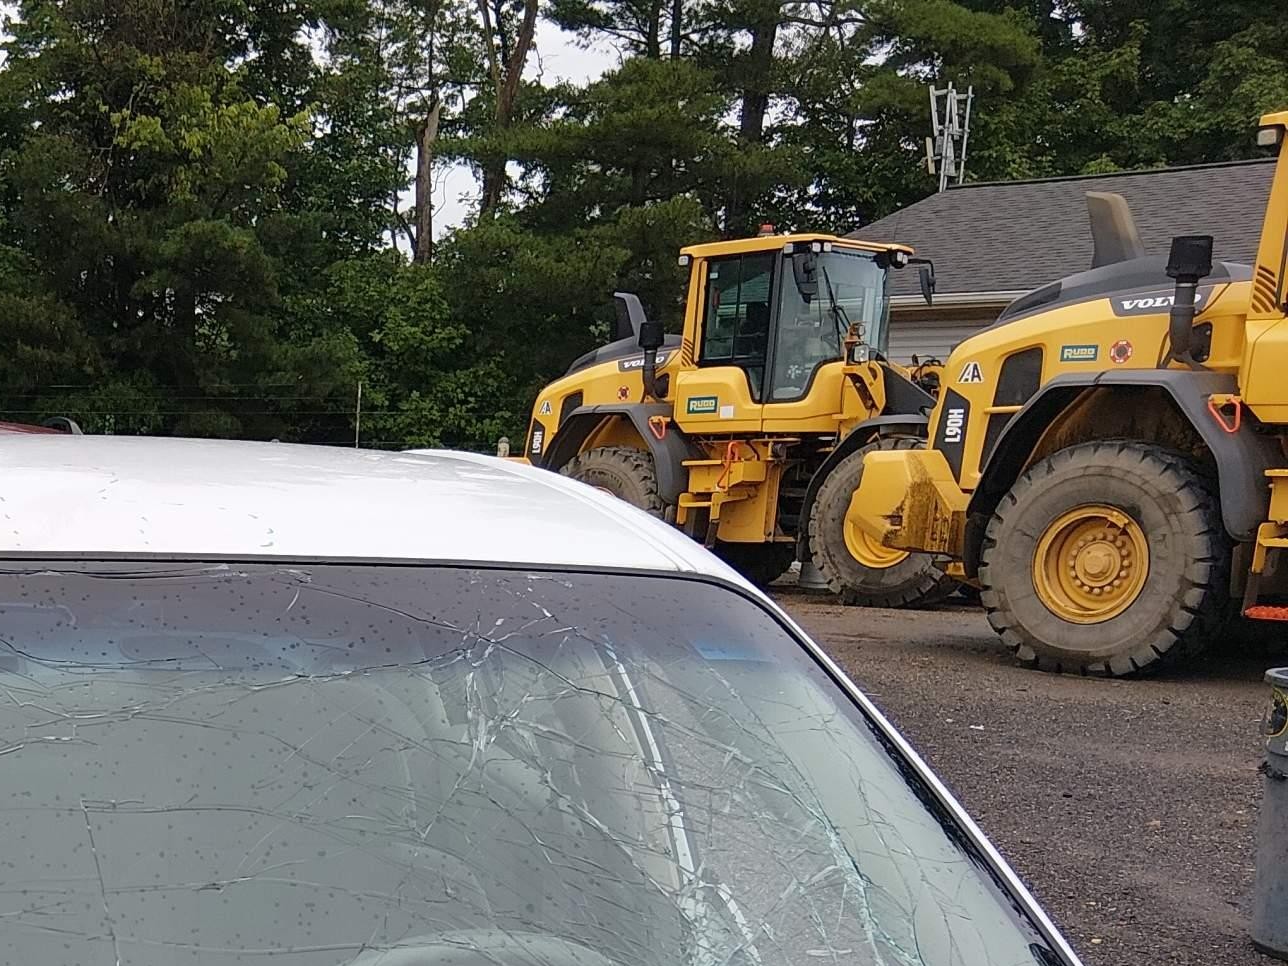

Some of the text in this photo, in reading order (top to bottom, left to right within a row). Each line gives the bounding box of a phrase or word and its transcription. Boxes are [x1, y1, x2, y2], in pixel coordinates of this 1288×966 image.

[623, 356, 665, 369] VOLO
[944, 408, 965, 443] L90H
[532, 431, 543, 454] L90H
